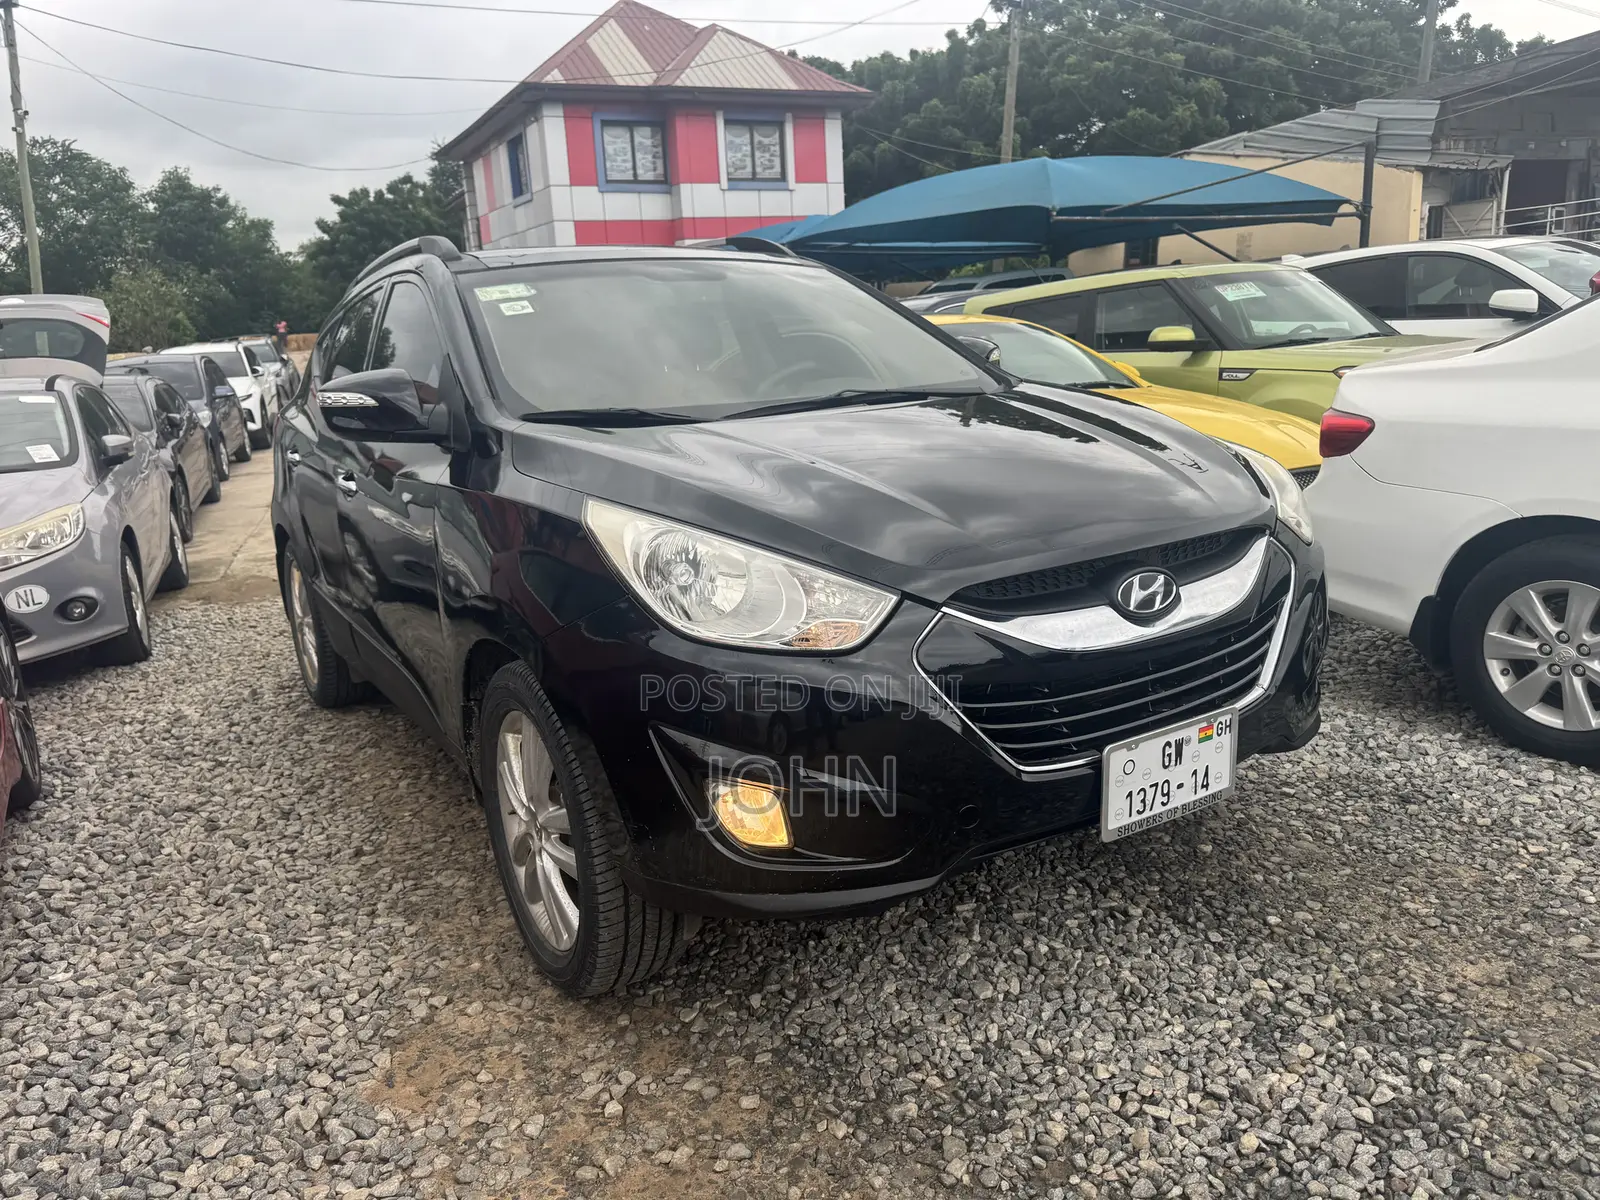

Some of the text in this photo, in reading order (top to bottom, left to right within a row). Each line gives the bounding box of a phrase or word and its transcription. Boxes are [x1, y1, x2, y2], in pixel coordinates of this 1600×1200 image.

[15, 589, 43, 609] NL
[1216, 717, 1232, 737] GH
[1162, 737, 1184, 769] GW
[1117, 791, 1223, 837] SHOWERS OF BLESSING
